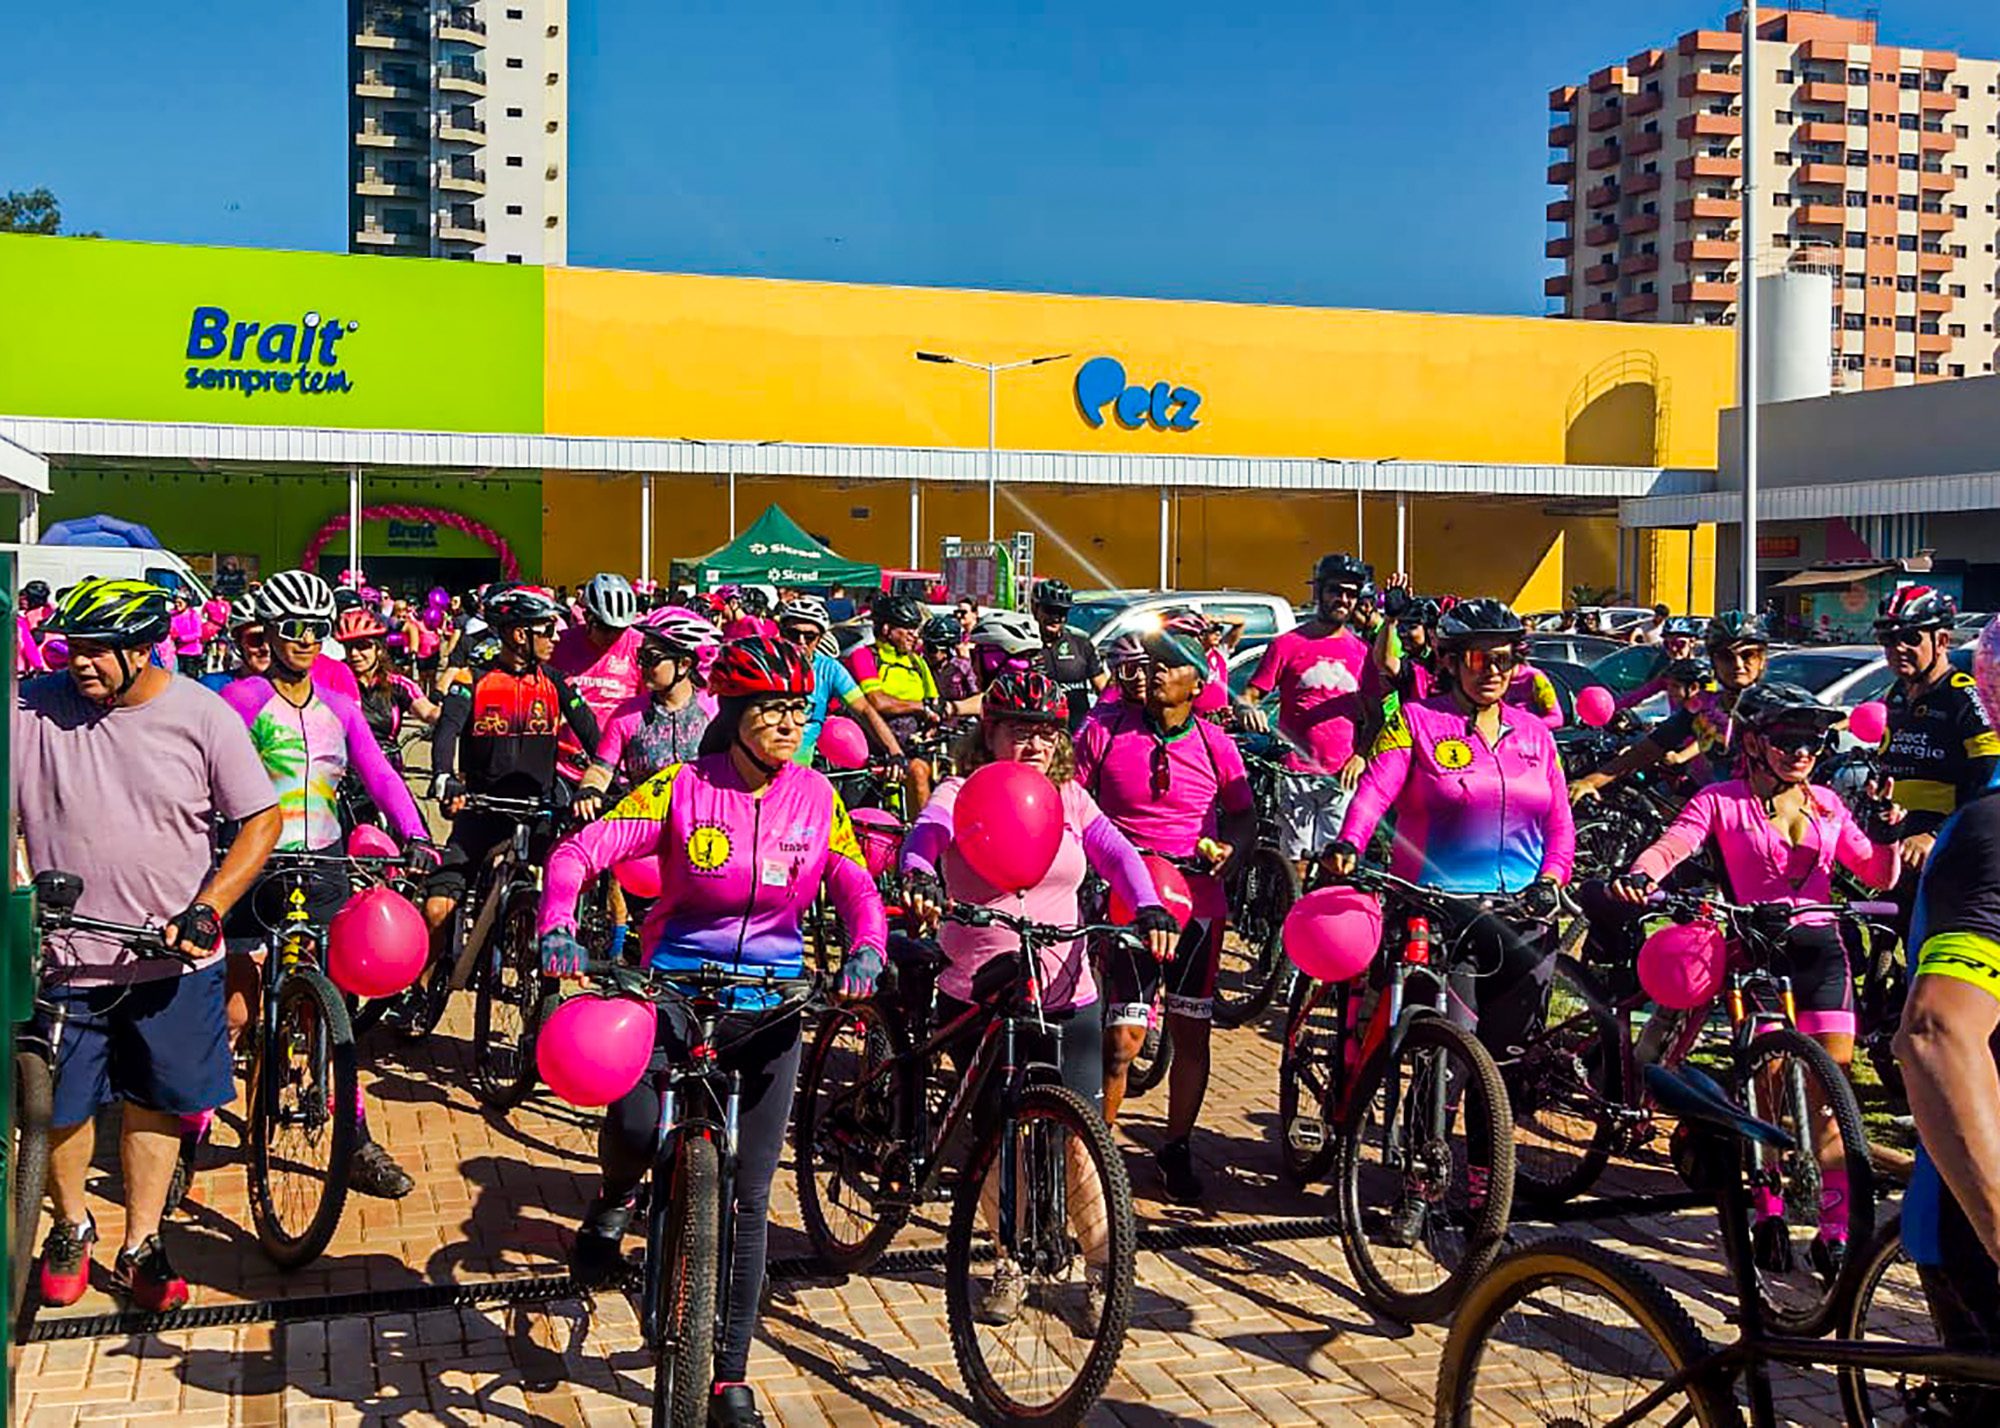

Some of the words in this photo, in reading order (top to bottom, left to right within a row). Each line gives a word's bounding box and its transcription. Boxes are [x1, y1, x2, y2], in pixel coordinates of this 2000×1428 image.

[186, 306, 345, 367] Brait
[1074, 357, 1202, 432] Petz
[781, 569, 819, 582] Sicredi
